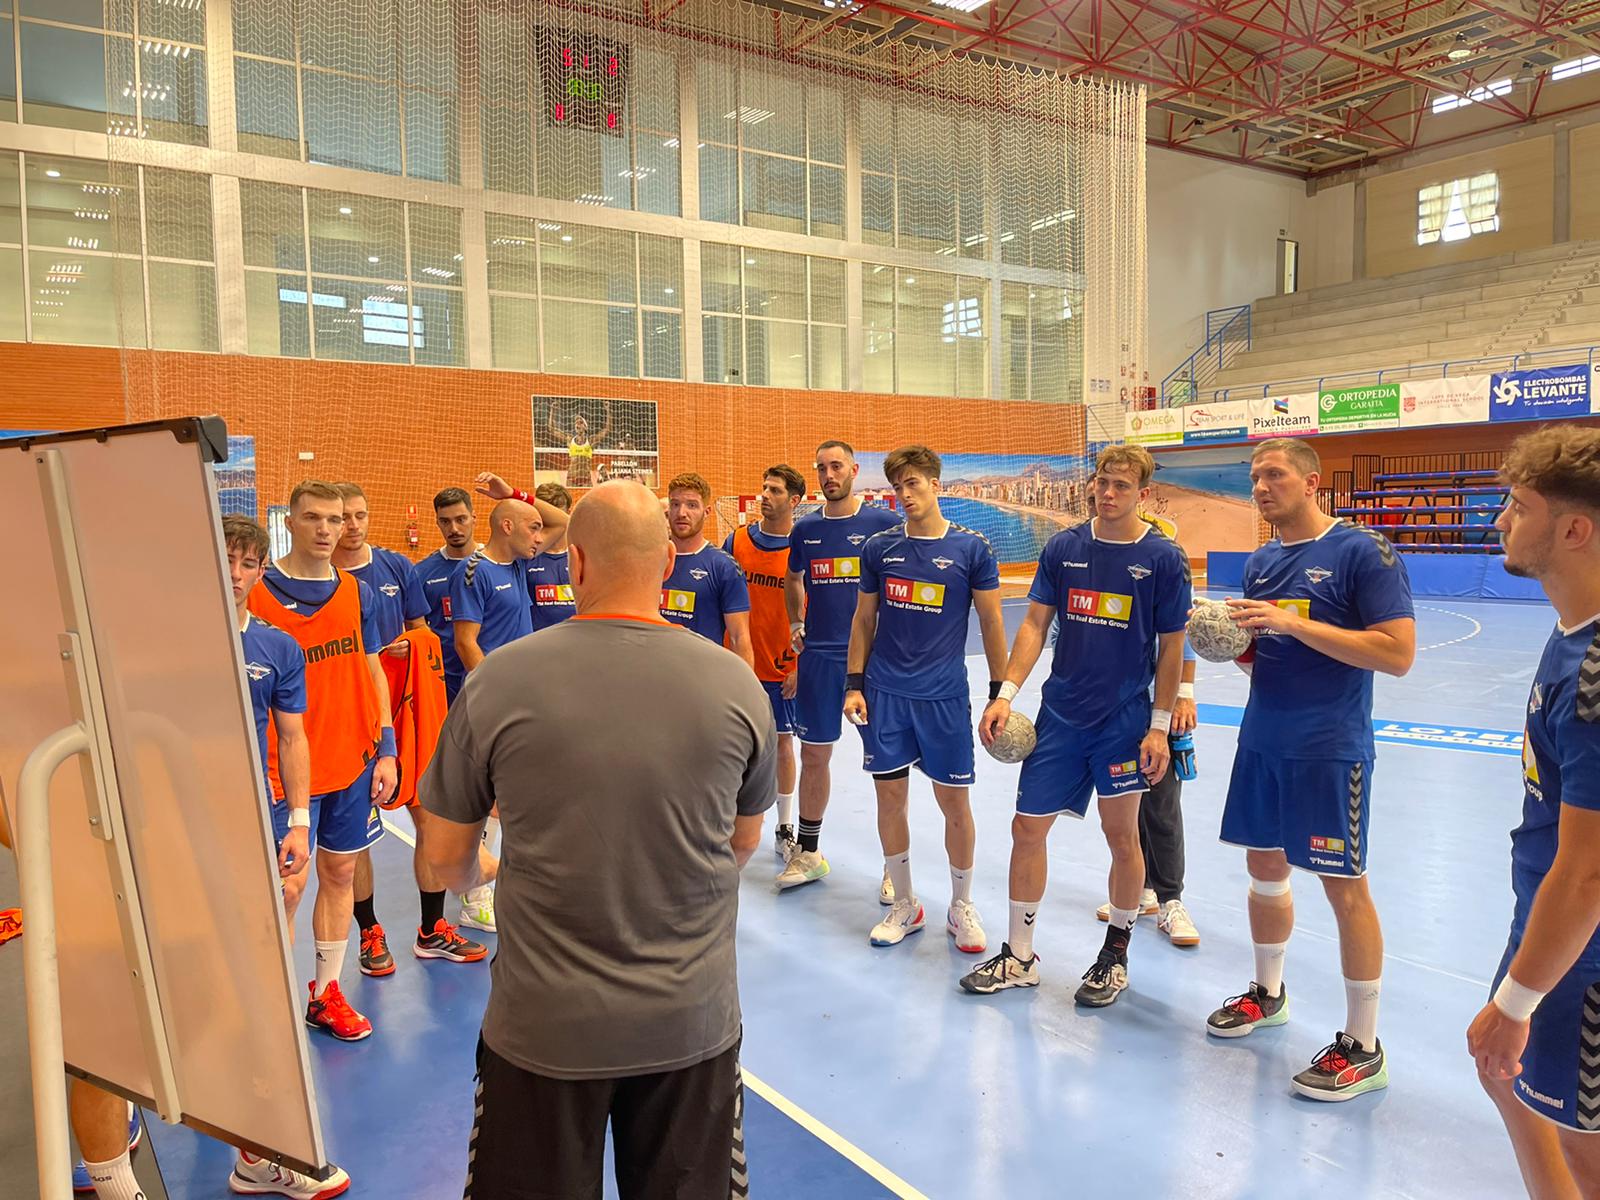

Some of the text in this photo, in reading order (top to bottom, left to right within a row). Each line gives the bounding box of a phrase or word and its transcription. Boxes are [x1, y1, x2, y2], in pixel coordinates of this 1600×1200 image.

[1523, 375, 1586, 387] ELECTROBOMBAS
[1339, 388, 1397, 403] ORTOPEDIA
[1523, 382, 1587, 399] LEVANTE
[1143, 414, 1176, 426] OMEGA
[1253, 415, 1311, 429] Pixelteam
[813, 563, 830, 575] TM
[538, 589, 555, 598] TM
[888, 583, 908, 598] TM
[905, 603, 922, 611] Estate
[923, 606, 943, 614] Group
[1072, 594, 1093, 610] TM
[678, 611, 694, 620] Group
[1088, 616, 1107, 625] Estate
[1108, 619, 1129, 630] Group
[303, 630, 359, 664] mmel
[1312, 839, 1325, 847] TM
[1317, 857, 1344, 868] hummel
[1526, 1084, 1564, 1109] hummel
